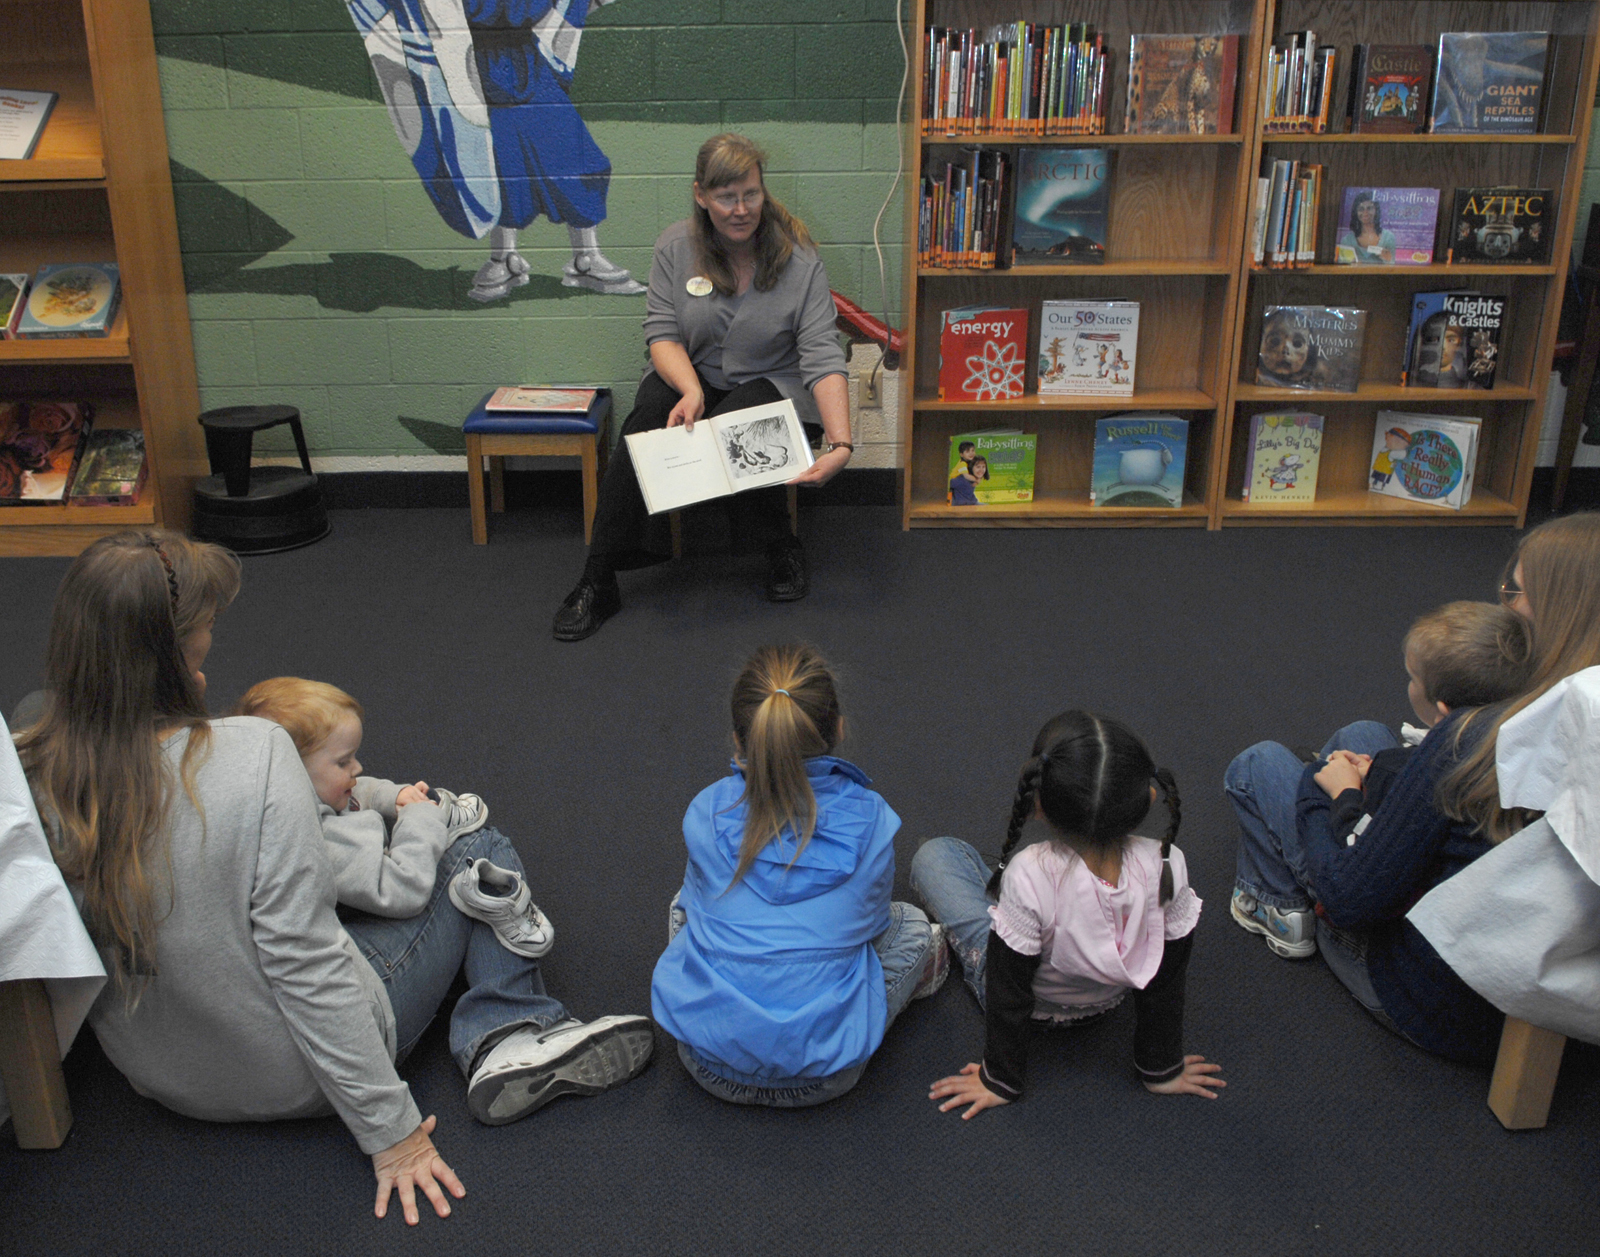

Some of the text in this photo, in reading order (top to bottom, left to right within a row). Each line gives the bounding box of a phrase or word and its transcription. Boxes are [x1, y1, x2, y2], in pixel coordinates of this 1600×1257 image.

[1370, 54, 1422, 73] Castle
[1486, 85, 1539, 96] GIANT
[1500, 97, 1521, 106] SEA
[1484, 106, 1535, 116] REPTILES
[1024, 163, 1107, 181] ARCTIC
[1371, 189, 1437, 206] Babysitting
[1462, 196, 1544, 216] AZTEC
[1442, 296, 1504, 318] Knights
[1048, 310, 1133, 328] Our 50 States
[1293, 315, 1358, 334] MYSTERIES
[1448, 315, 1501, 328] & Castles
[951, 321, 1014, 338] energy
[1306, 333, 1356, 348] MUMMY
[1106, 421, 1160, 439] Russell
[977, 437, 1035, 451] Babysitting
[1256, 435, 1320, 454] Lilly's Big Day
[1415, 432, 1459, 459] Is There
[1414, 447, 1449, 472] Really
[1410, 461, 1451, 484] Human
[1404, 474, 1443, 498] RACE?
